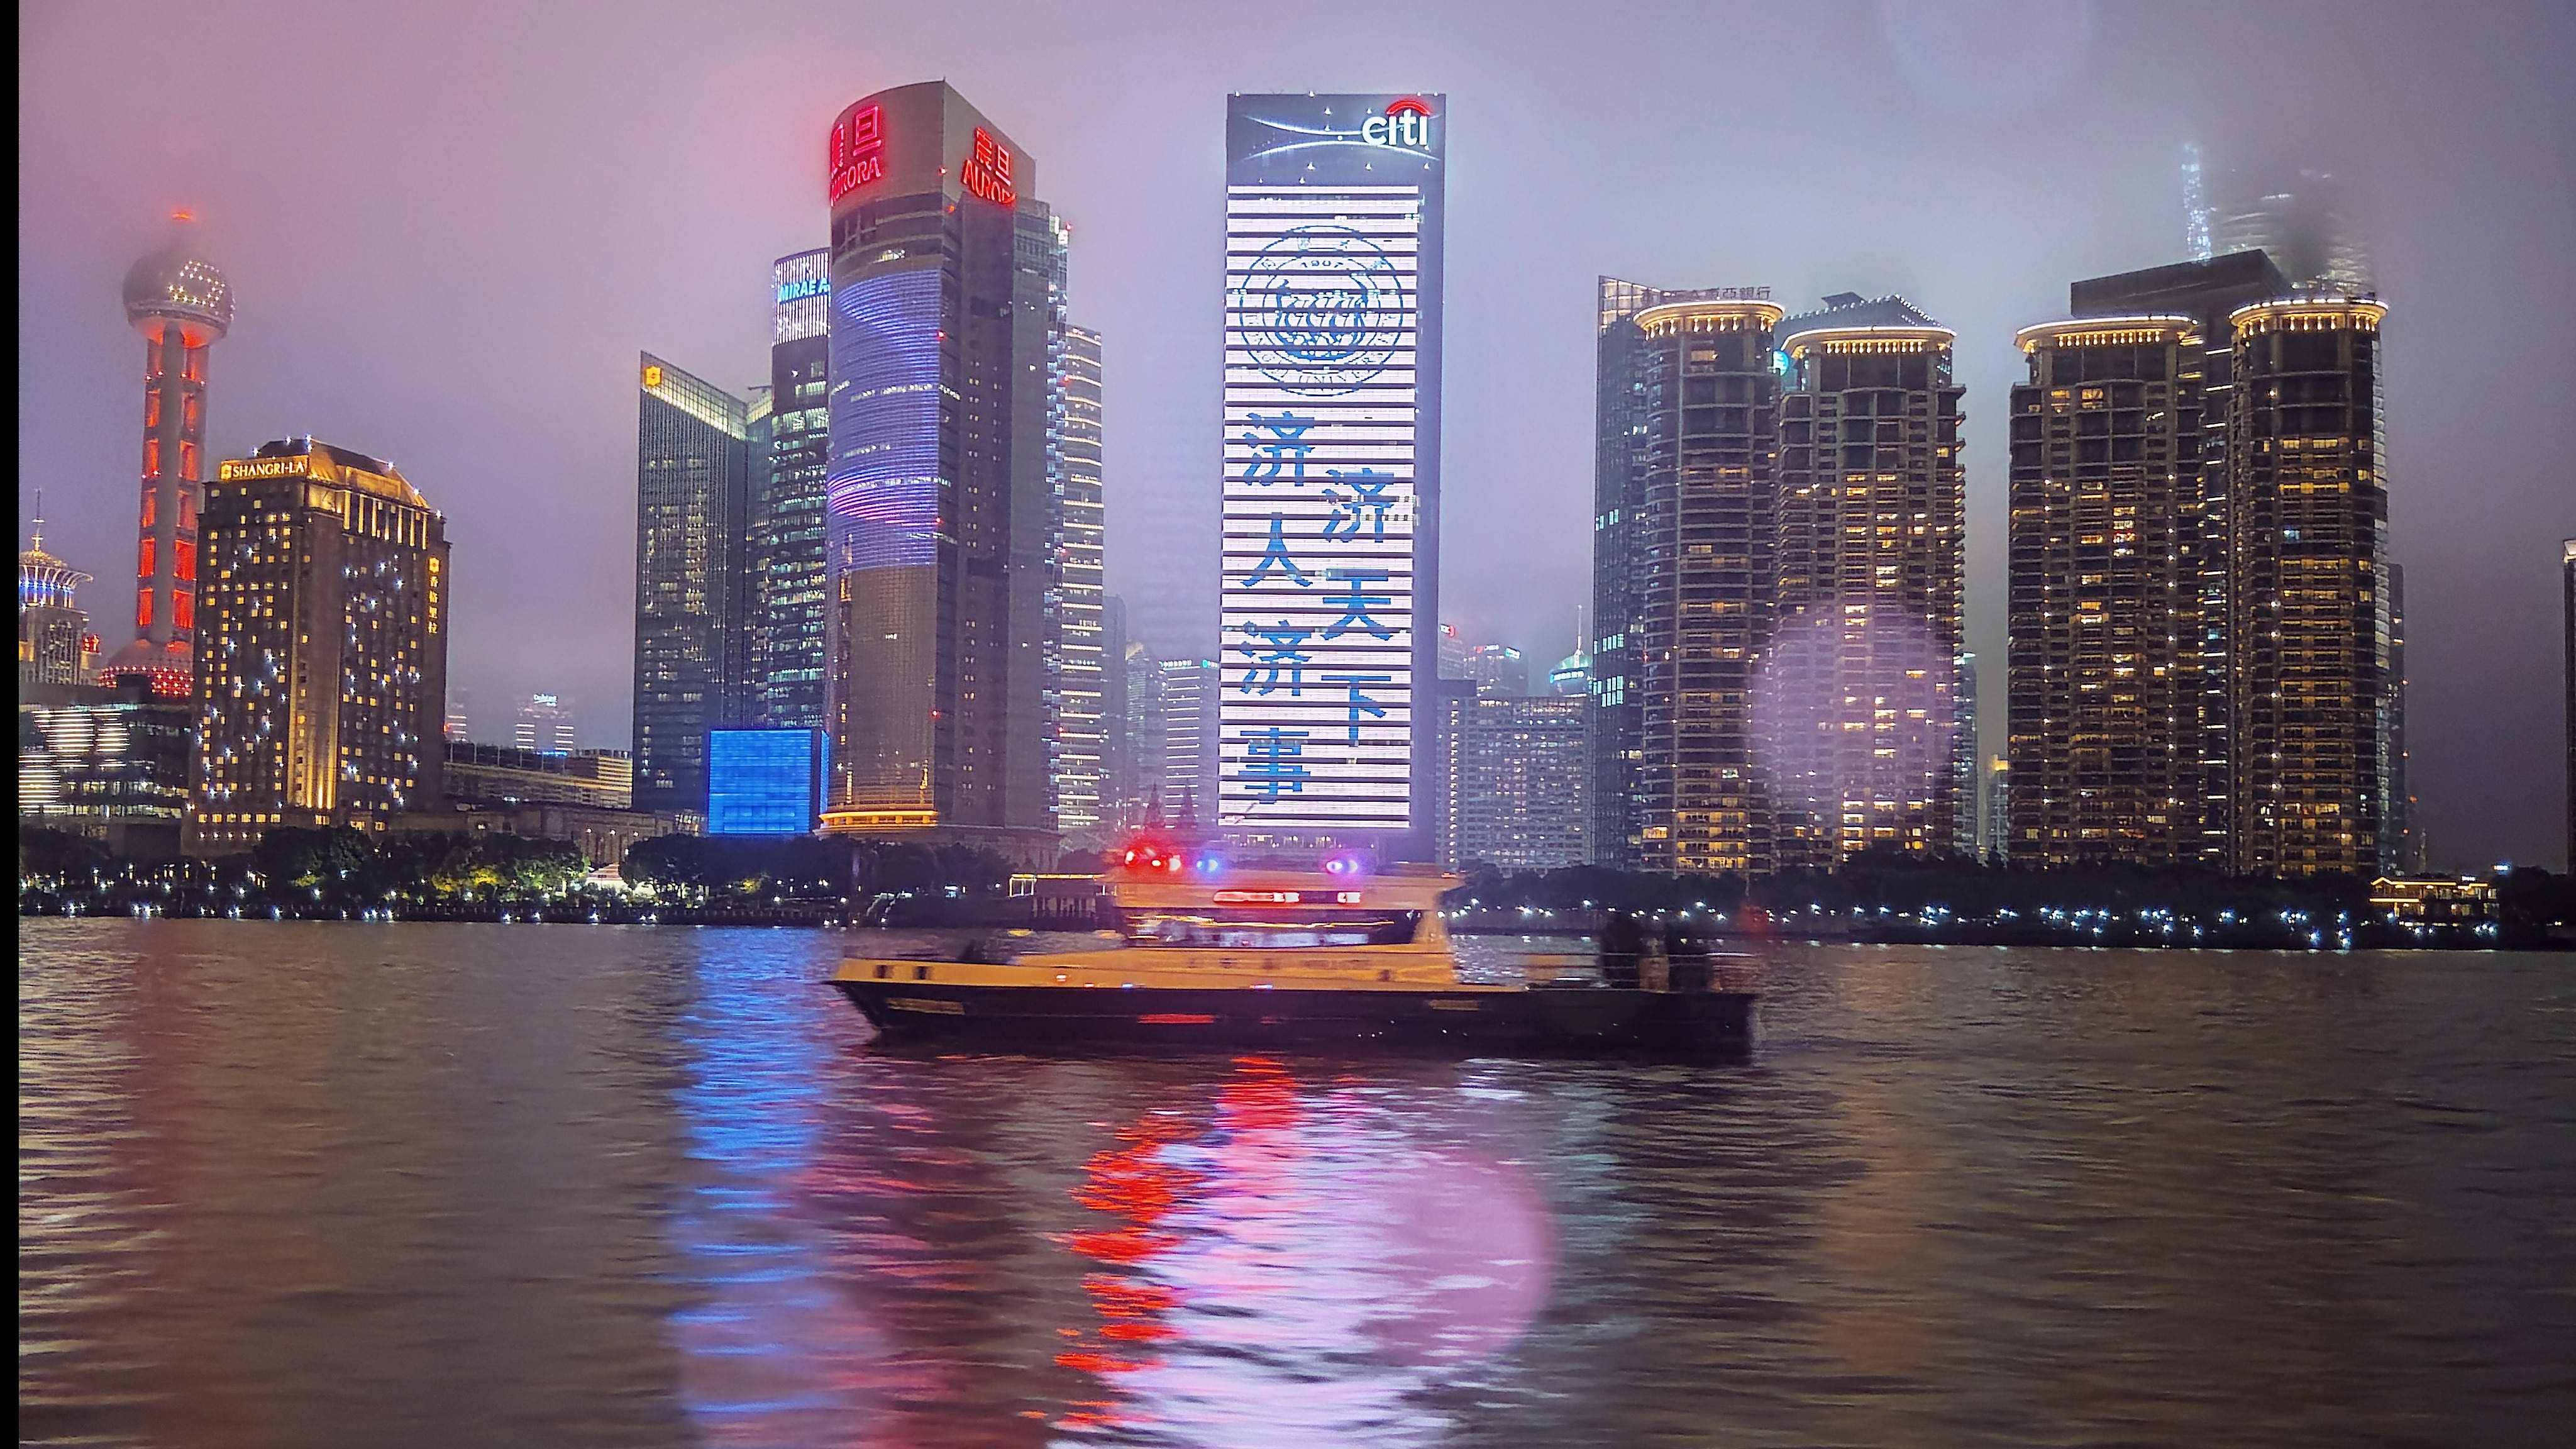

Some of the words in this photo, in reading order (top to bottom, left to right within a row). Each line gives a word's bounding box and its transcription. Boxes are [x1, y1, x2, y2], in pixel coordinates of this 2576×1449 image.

[1362, 109, 1427, 146] citi
[778, 279, 817, 303] MIRAE
[232, 461, 305, 478] SHANGRI-LA
[1237, 411, 1315, 804] 济人济事
[1320, 467, 1395, 748] 济天下
